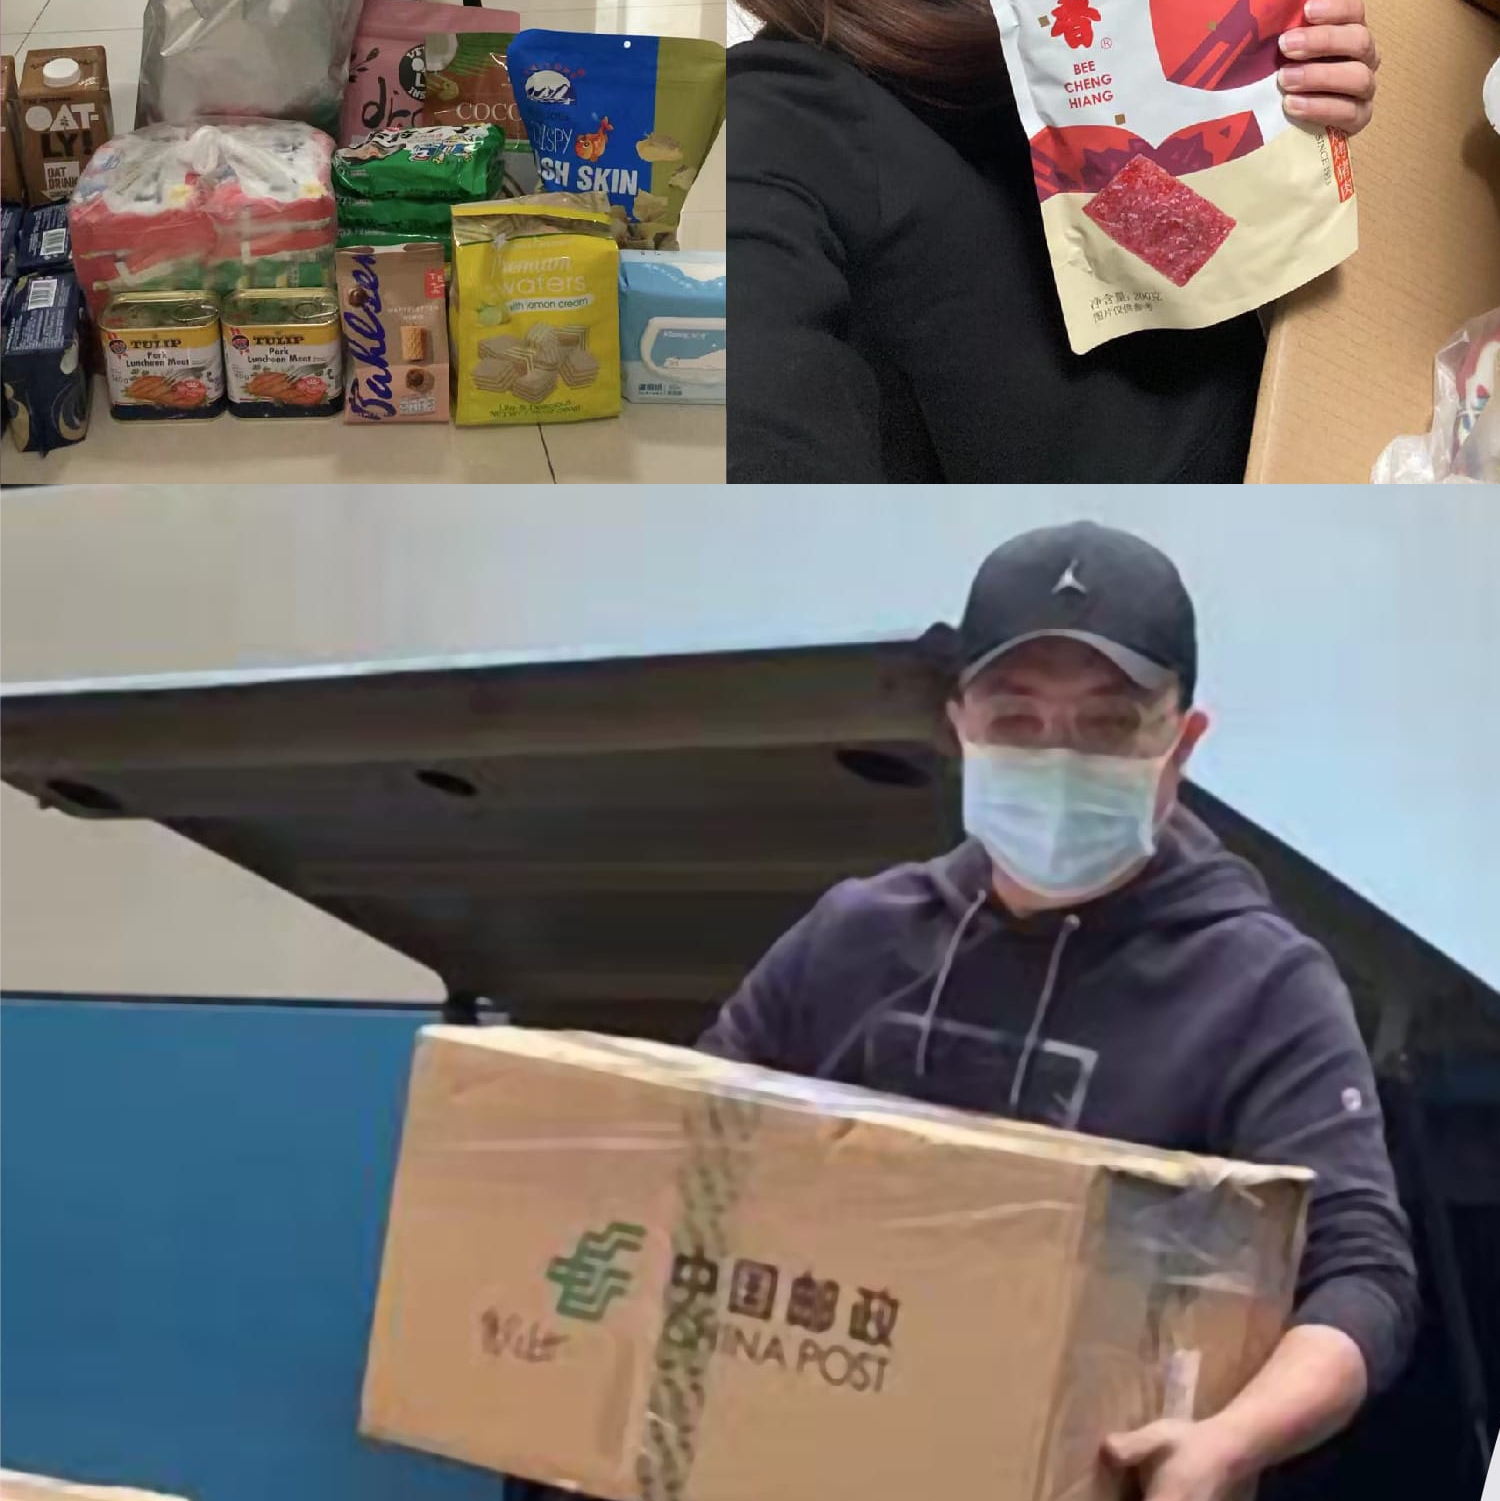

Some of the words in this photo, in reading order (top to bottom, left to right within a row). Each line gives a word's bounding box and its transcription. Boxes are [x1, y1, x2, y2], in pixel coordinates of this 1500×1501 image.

[1073, 59, 1096, 76] BEE
[1063, 74, 1113, 94] CHENG
[1068, 90, 1114, 109] HIANG
[25, 102, 100, 132] OAT-
[46, 165, 67, 179] OAT
[575, 164, 638, 196] SKIN
[130, 338, 182, 349] TULIP
[252, 334, 305, 346] TULIP
[672, 1244, 900, 1348] 中国邮政
[796, 1336, 890, 1394] POST
